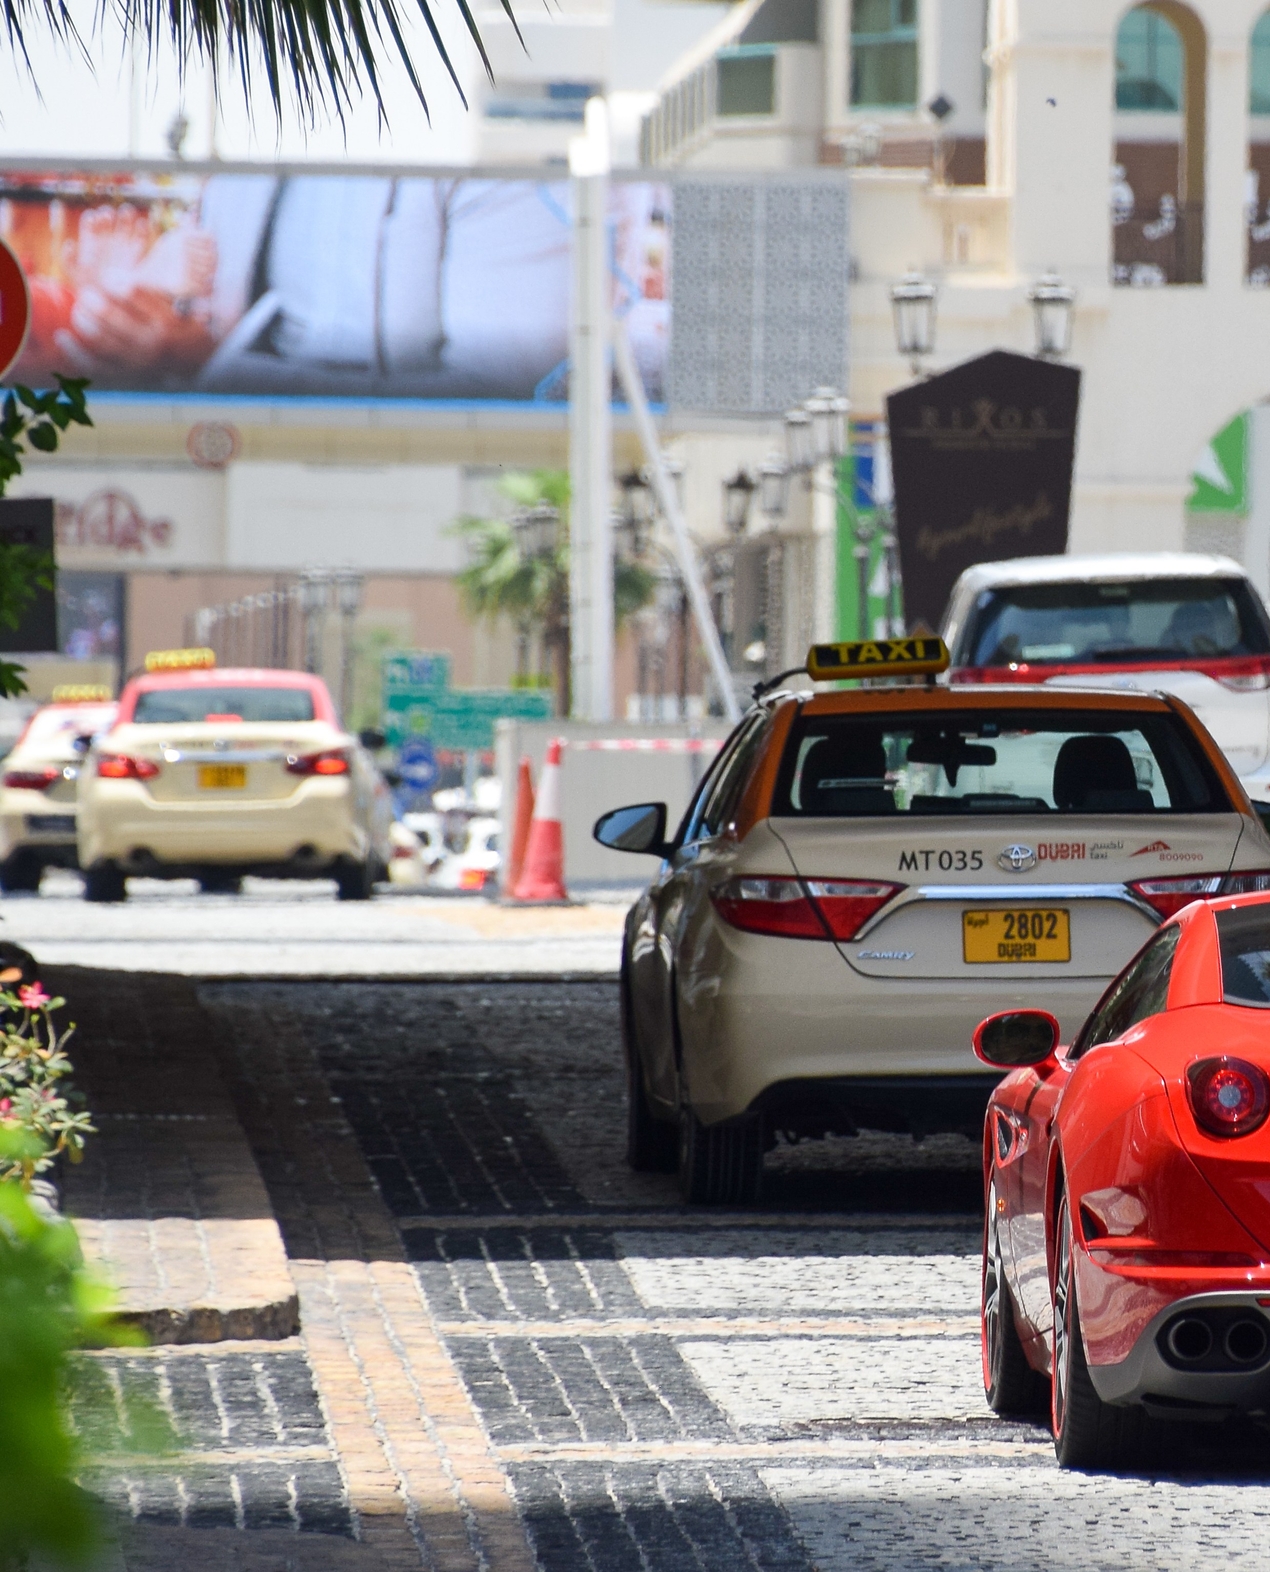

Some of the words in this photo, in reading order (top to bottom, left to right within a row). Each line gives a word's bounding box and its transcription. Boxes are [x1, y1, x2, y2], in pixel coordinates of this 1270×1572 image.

[830, 640, 925, 664] TAXI
[1037, 842, 1086, 862] DUBAI
[1003, 912, 1058, 940] 2802
